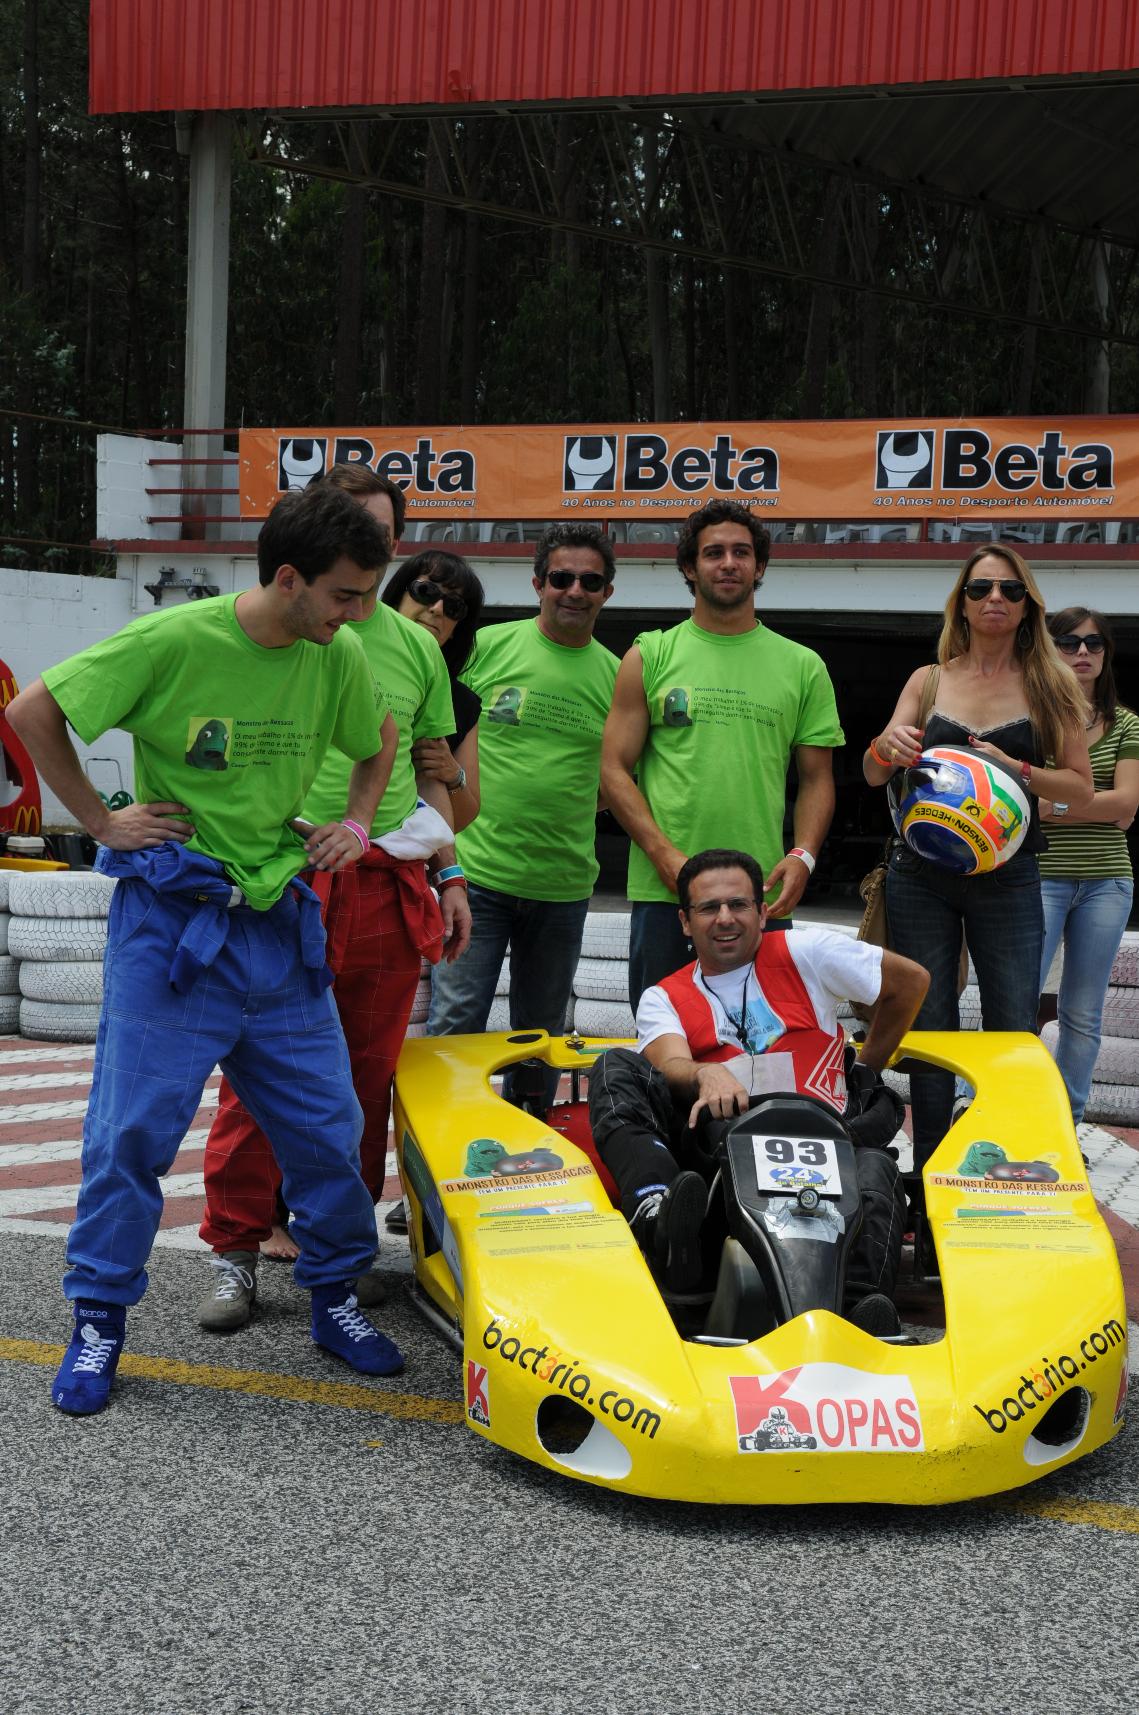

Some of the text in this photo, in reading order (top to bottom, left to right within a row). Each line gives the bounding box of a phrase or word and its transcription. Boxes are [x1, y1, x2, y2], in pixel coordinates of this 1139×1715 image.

[622, 433, 780, 492] Beta
[941, 428, 1115, 492] Beta
[561, 498, 579, 507] 40
[582, 498, 616, 507] Anos
[620, 498, 636, 507] no
[639, 497, 702, 508] Desporto
[873, 495, 1114, 508] 40 Anos no Desporto Automóvel
[915, 808, 952, 821] HEDGES
[956, 820, 988, 853] BENSON
[764, 1139, 828, 1166] 93
[446, 1166, 592, 1193] O MONSTRO DAS RESSACAS
[935, 1177, 1085, 1192] O MONSTRO DAS RESSACAS
